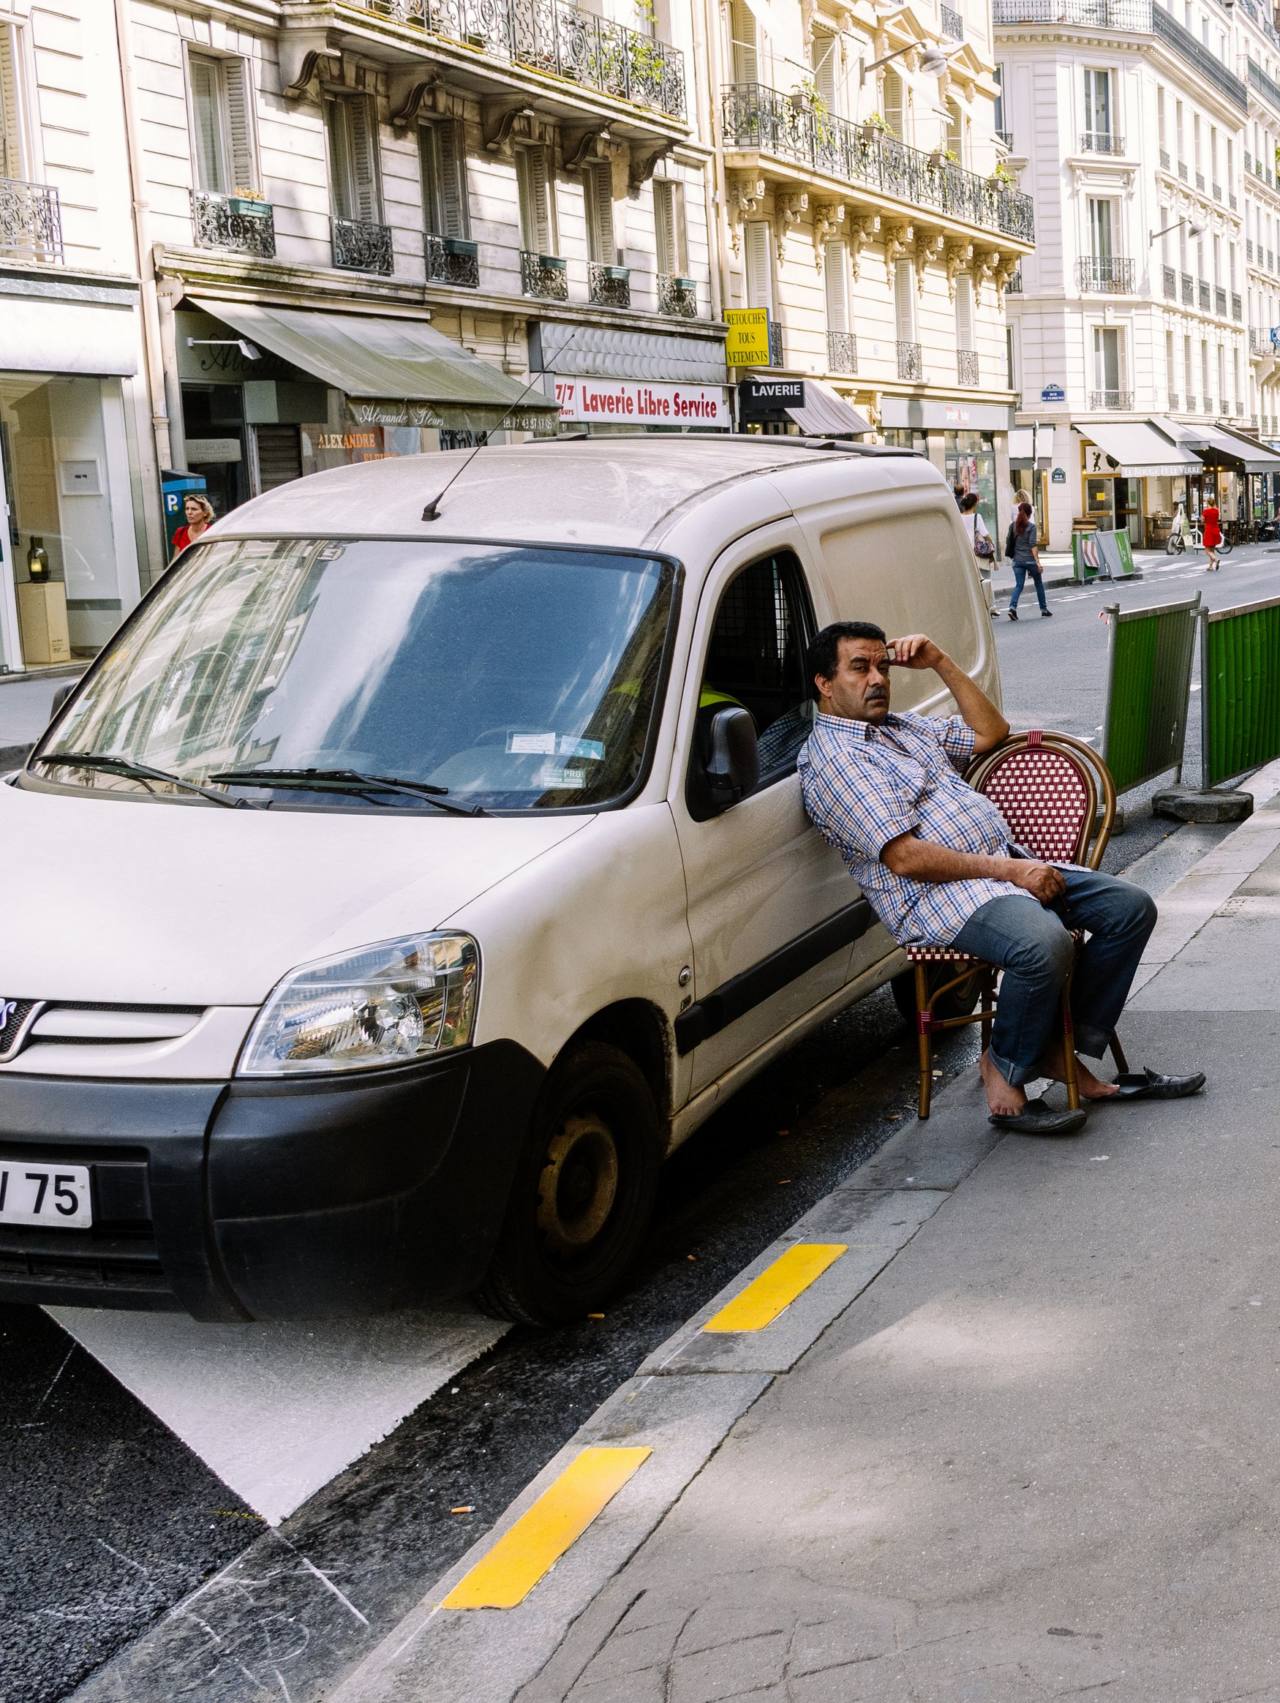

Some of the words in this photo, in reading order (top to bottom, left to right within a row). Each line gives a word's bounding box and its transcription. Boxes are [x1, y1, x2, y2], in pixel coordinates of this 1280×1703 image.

[727, 312, 766, 326] RETOUCHES
[738, 332, 755, 344] TOUS
[751, 384, 801, 397] LAVERIE
[555, 384, 574, 405] 7/7
[582, 385, 634, 415] Laverie
[637, 389, 670, 418] Libre
[673, 392, 717, 419] Service
[318, 433, 376, 449] ALEXANDRE
[25, 1171, 79, 1216] 75
